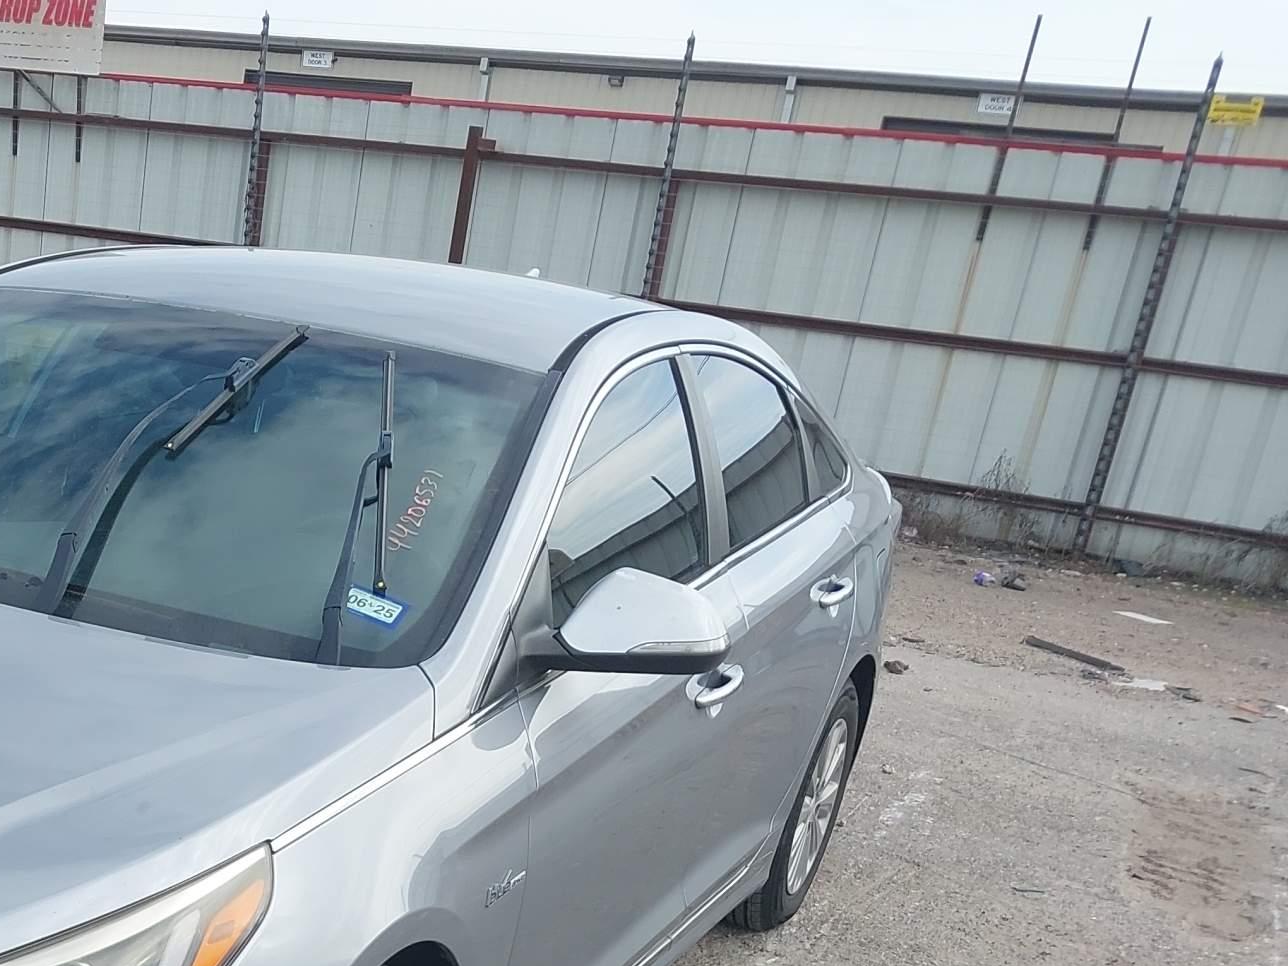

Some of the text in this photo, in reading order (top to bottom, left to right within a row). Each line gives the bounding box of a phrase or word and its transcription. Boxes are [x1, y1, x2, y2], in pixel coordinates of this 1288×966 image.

[42, 0, 96, 28] ZONE
[387, 469, 444, 551] 44206531
[349, 594, 396, 618] 06 25
